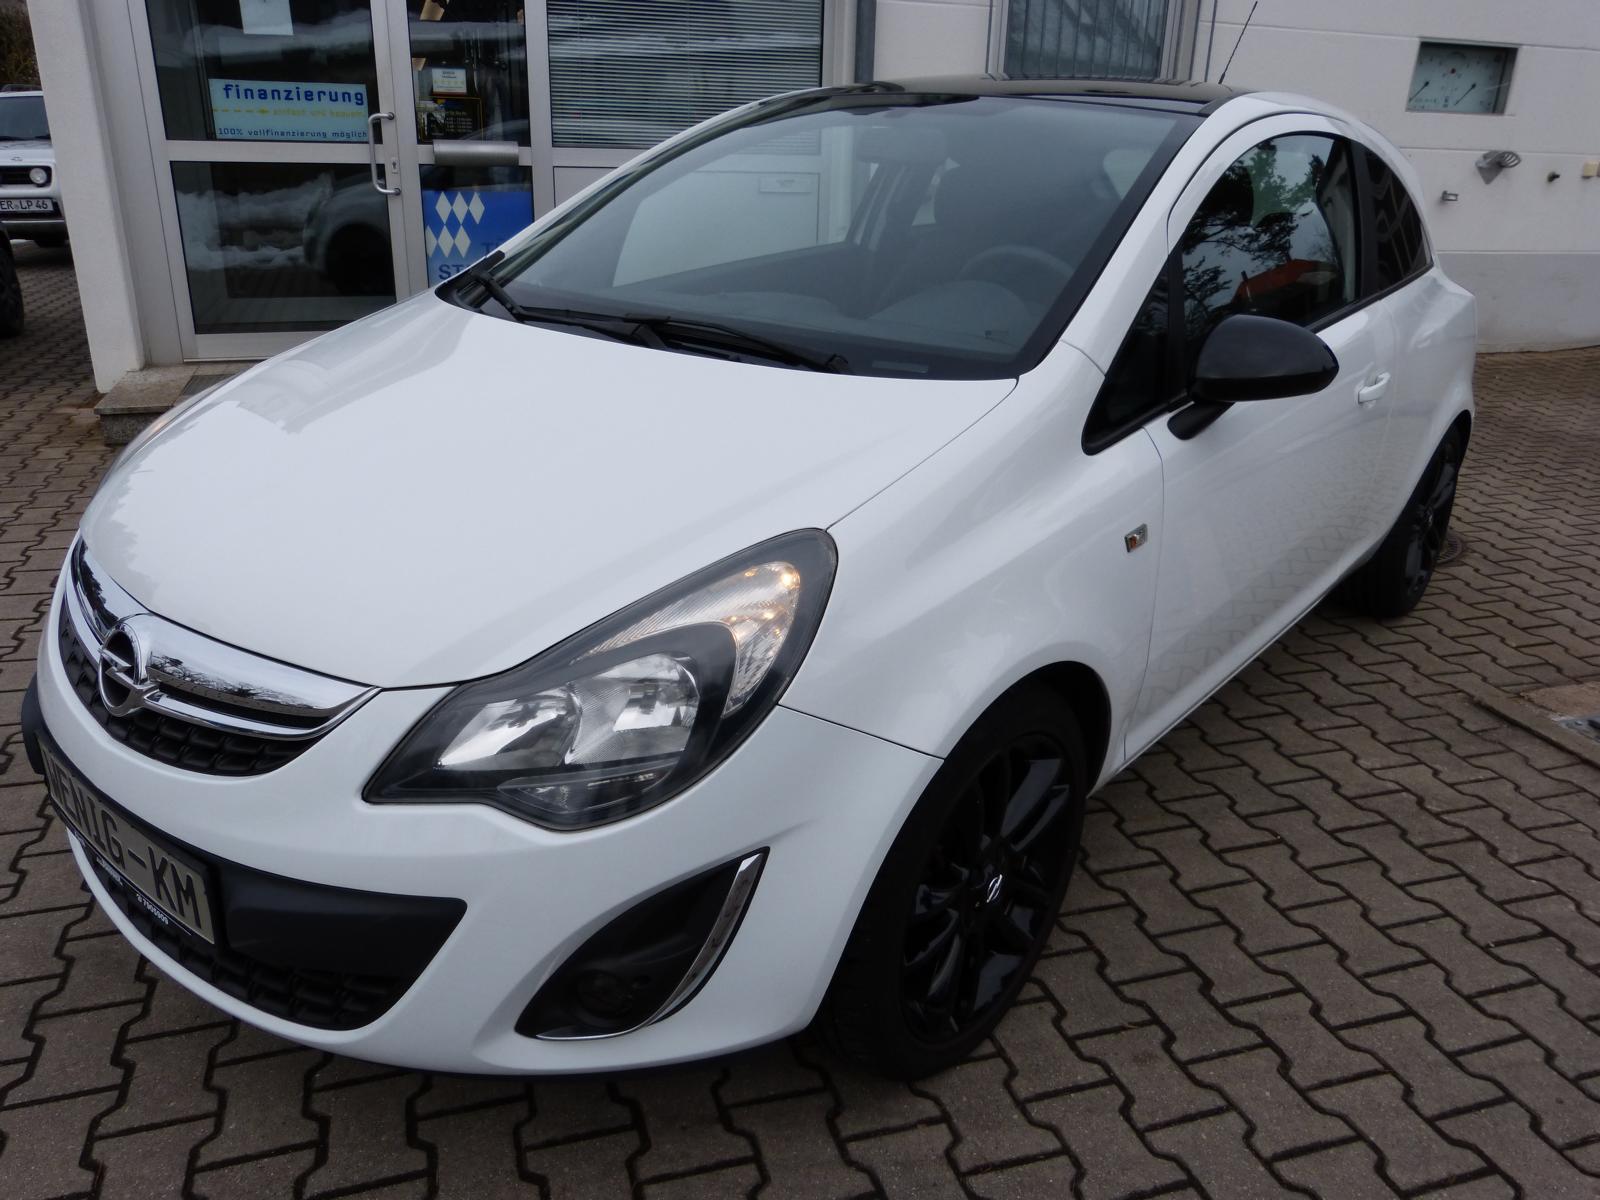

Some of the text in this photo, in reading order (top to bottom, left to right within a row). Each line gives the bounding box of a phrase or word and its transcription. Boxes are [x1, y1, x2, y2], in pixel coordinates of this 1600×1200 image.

[223, 84, 364, 106] finanzierung
[218, 127, 367, 139] 100% vollfinanzierung möglich
[20, 200, 33, 209] LP
[43, 750, 202, 929] WENIG-KM
